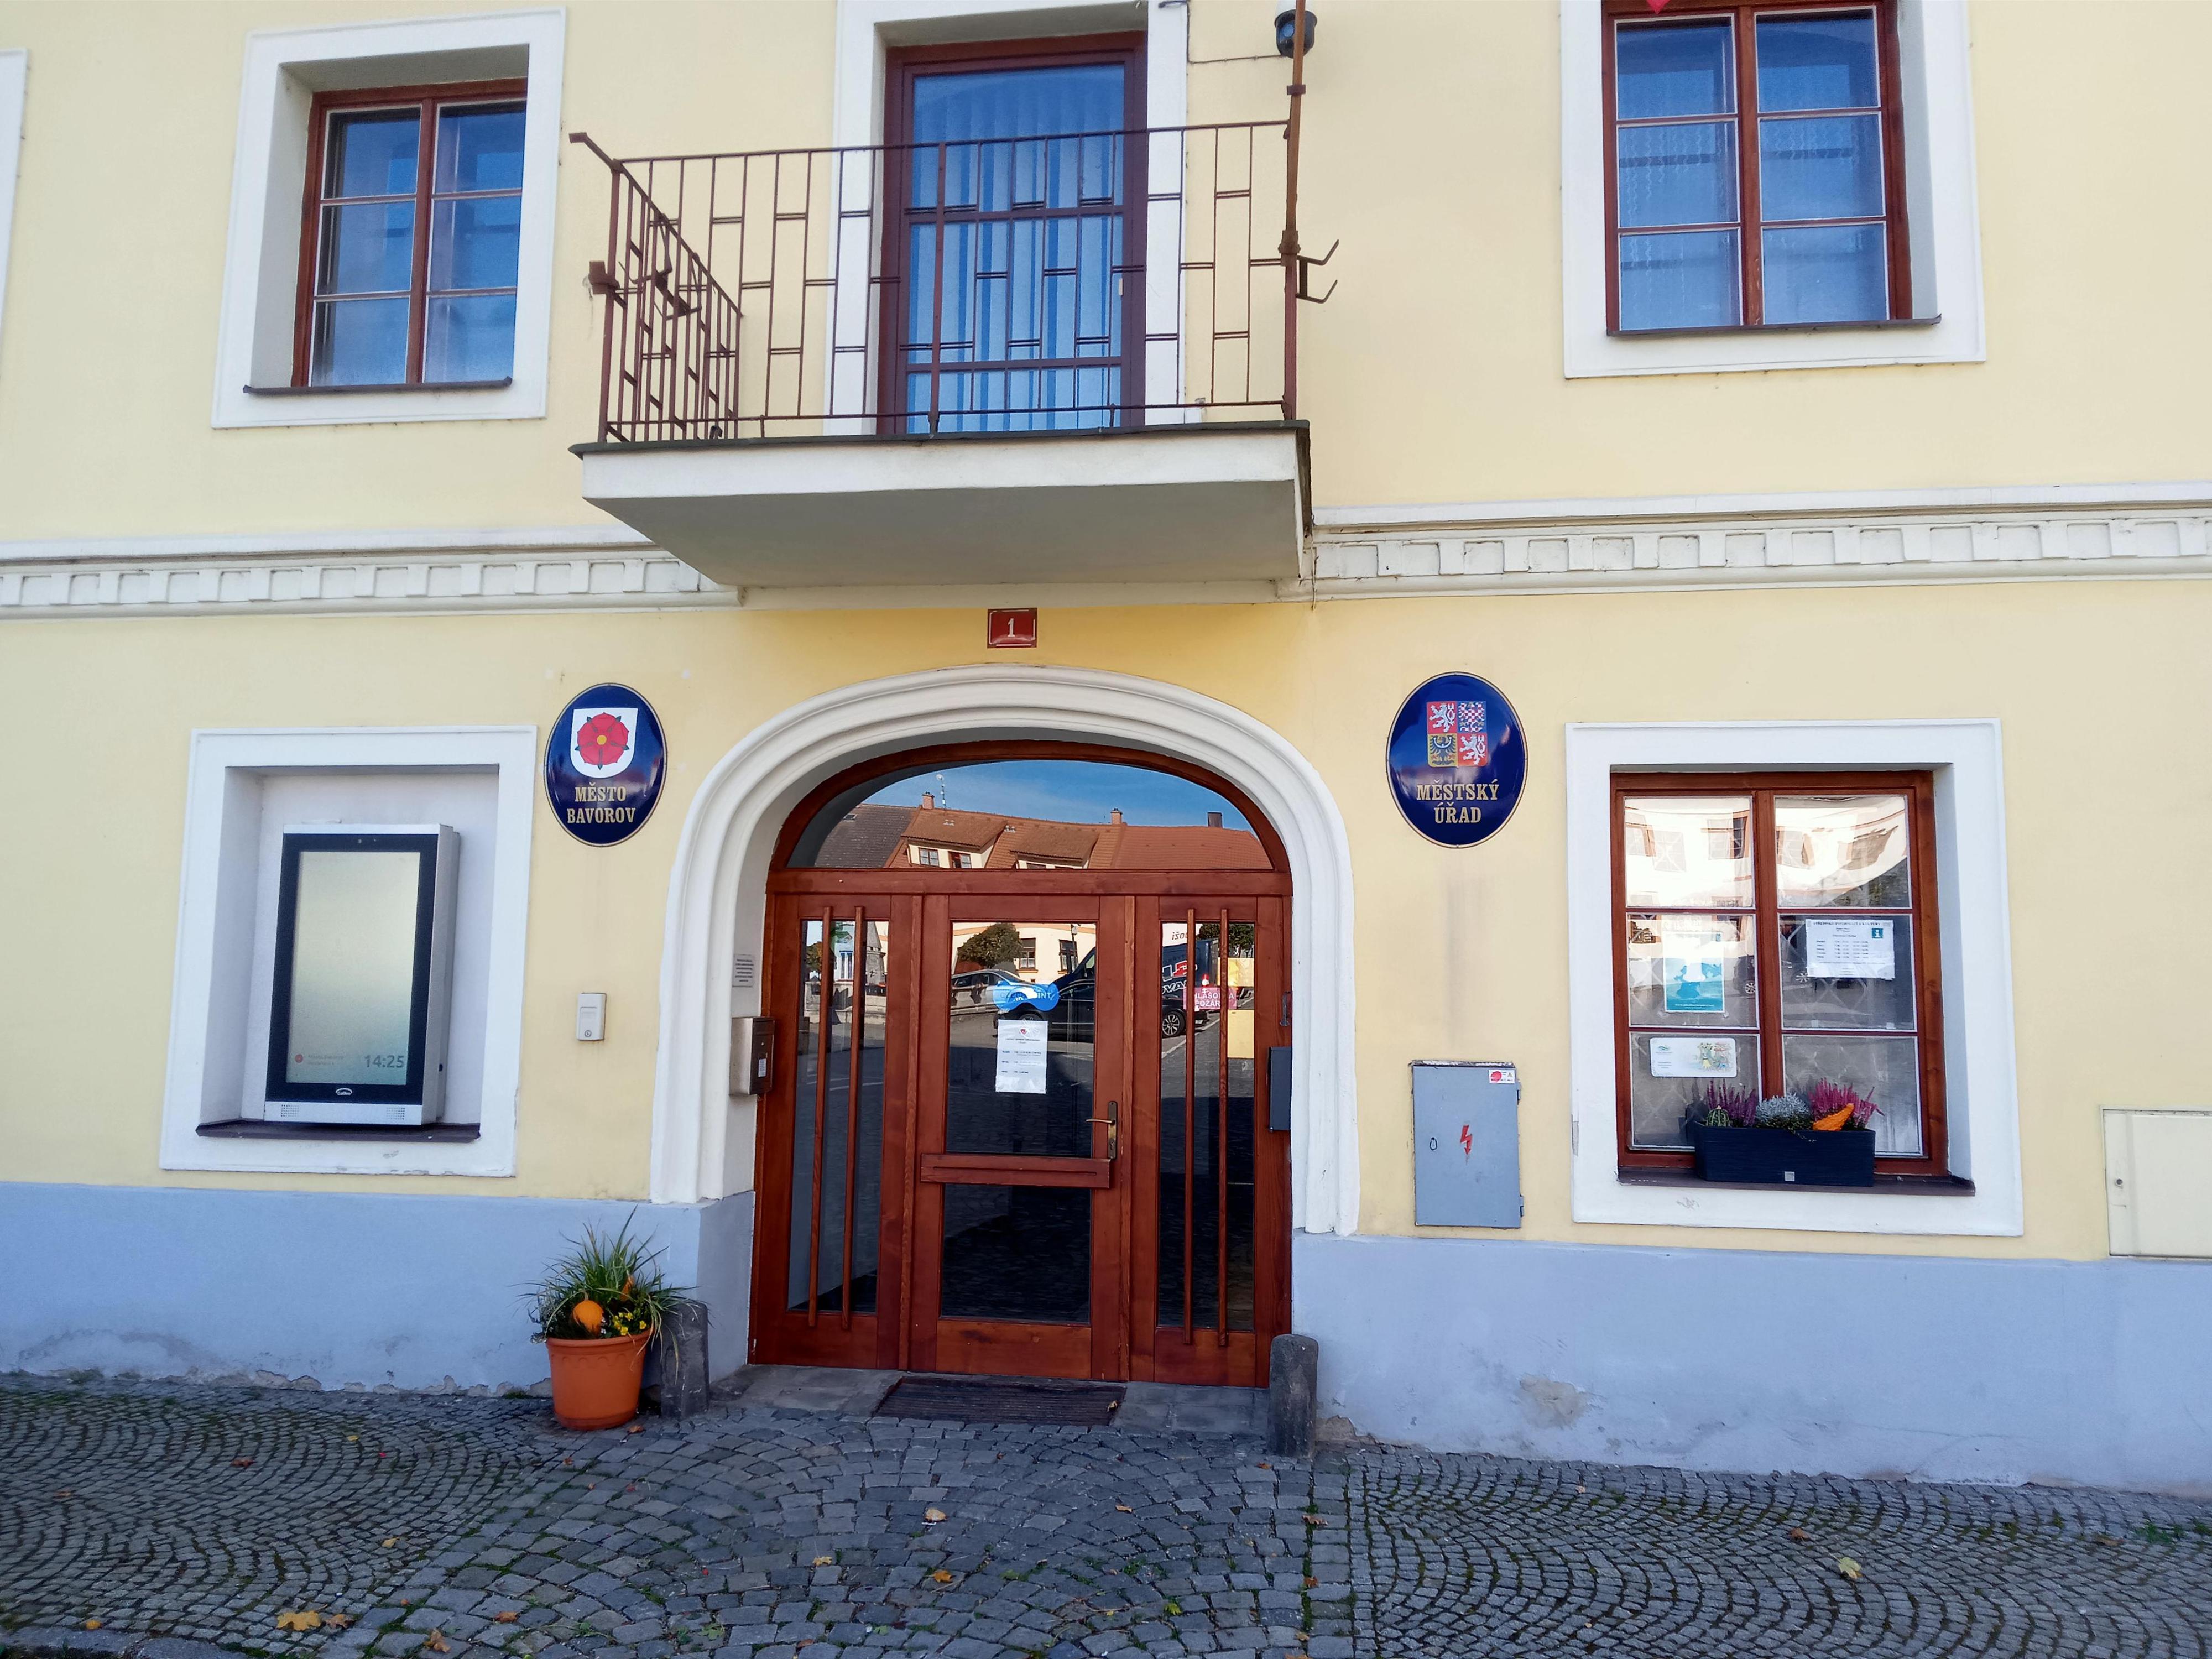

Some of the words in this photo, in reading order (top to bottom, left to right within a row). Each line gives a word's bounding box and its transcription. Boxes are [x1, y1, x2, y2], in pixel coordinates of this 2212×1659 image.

[1007, 618, 1015, 638] 1
[574, 782, 627, 802] MĚSTO
[1416, 779, 1500, 801] MĚSTSKÝ
[566, 807, 637, 825] BAVOROV
[1434, 802, 1482, 824] ÚŘAD
[364, 1055, 405, 1068] 14:25
